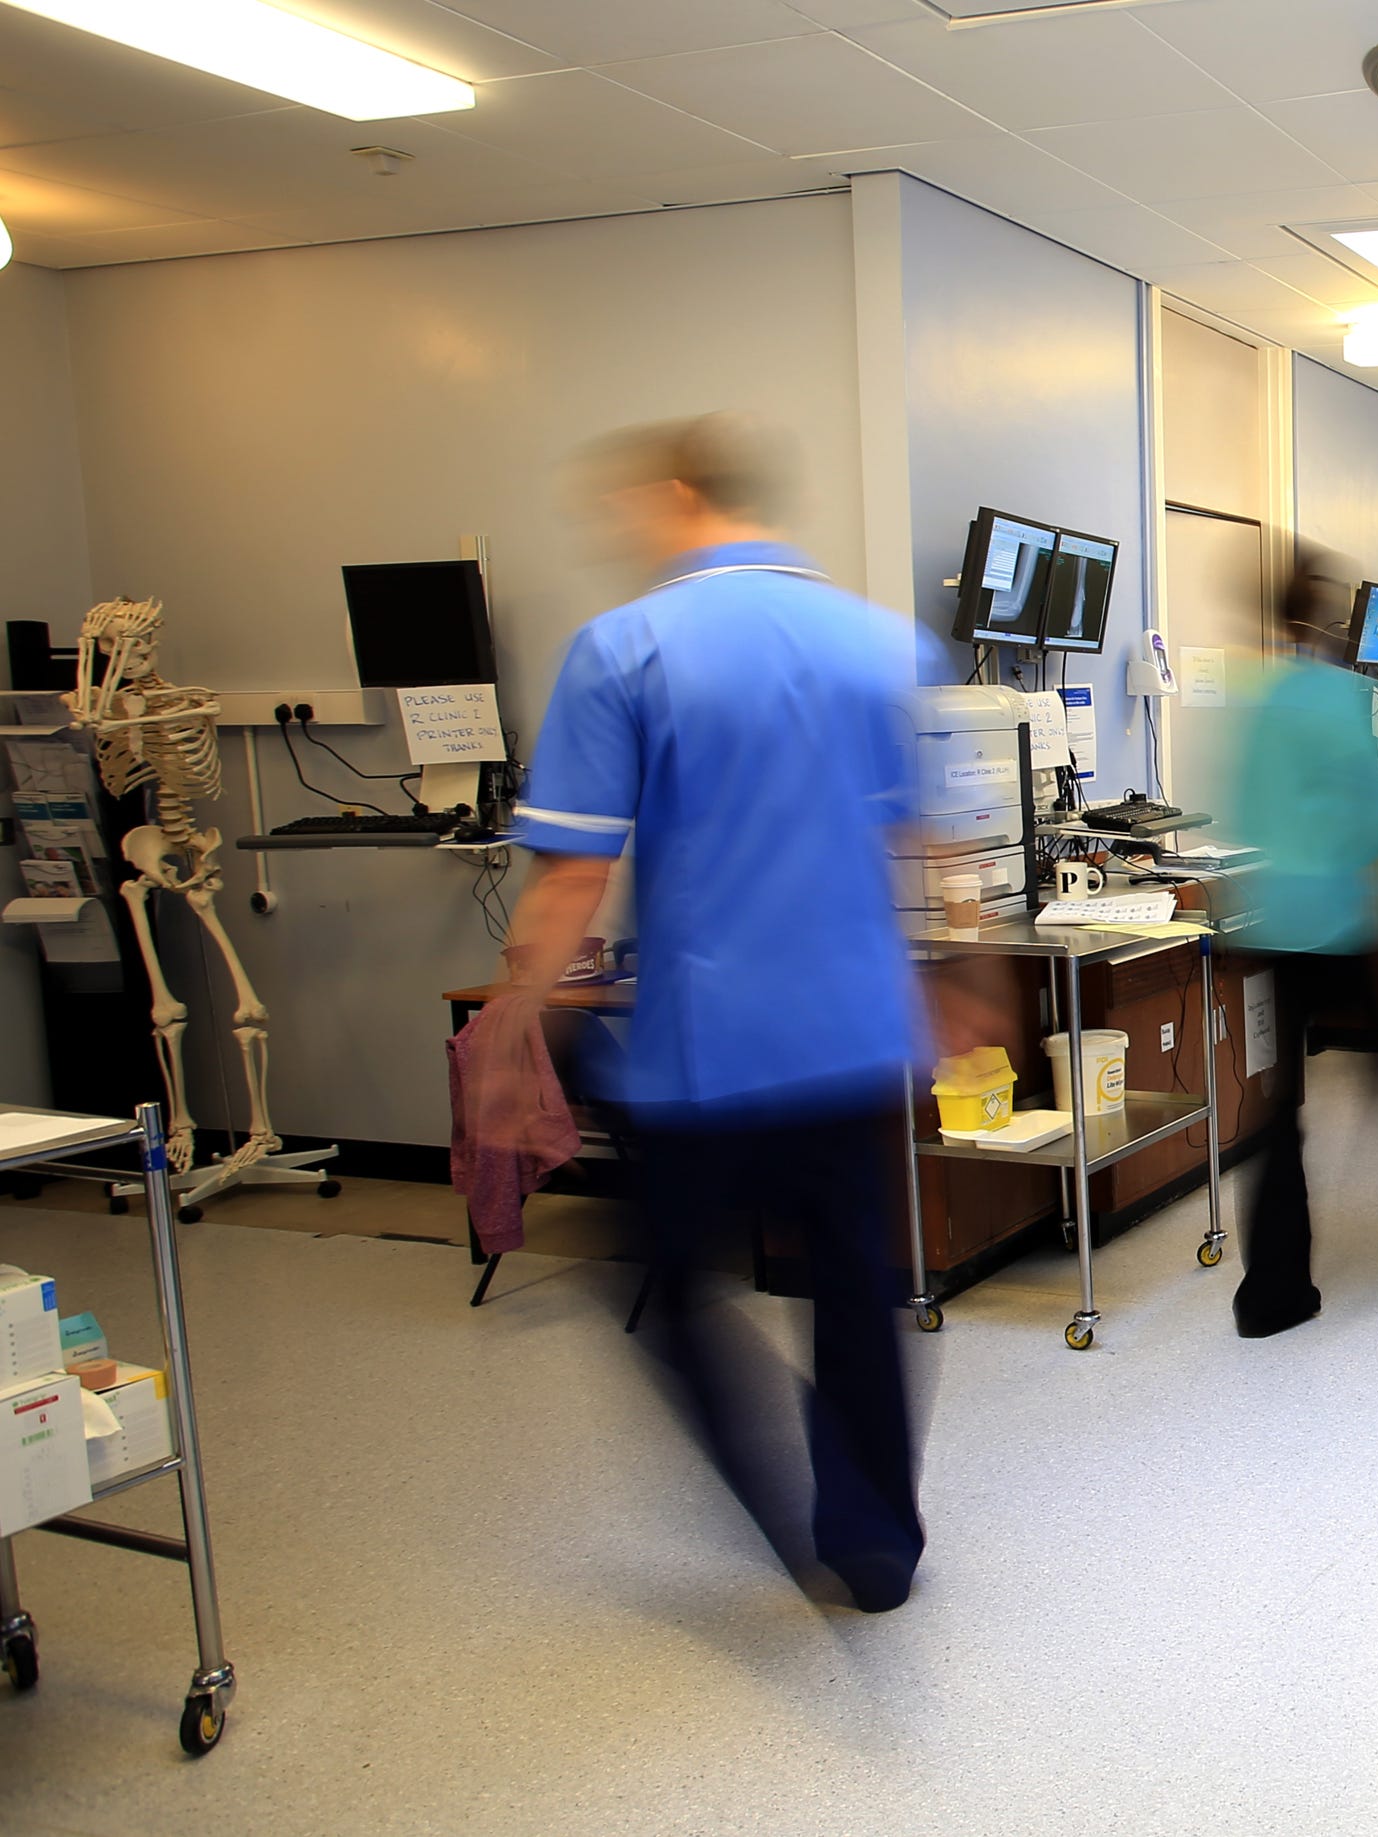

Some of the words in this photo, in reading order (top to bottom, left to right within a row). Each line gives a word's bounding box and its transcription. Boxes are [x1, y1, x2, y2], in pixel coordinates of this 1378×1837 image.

[404, 694, 455, 707] PLEASE
[464, 692, 484, 703] USE
[1037, 698, 1050, 707] USE
[429, 710, 467, 722] CLINIC
[1046, 712, 1052, 723] 2
[416, 727, 474, 740] PRINTER
[442, 741, 484, 752] THANKS
[1060, 872, 1078, 893] P
